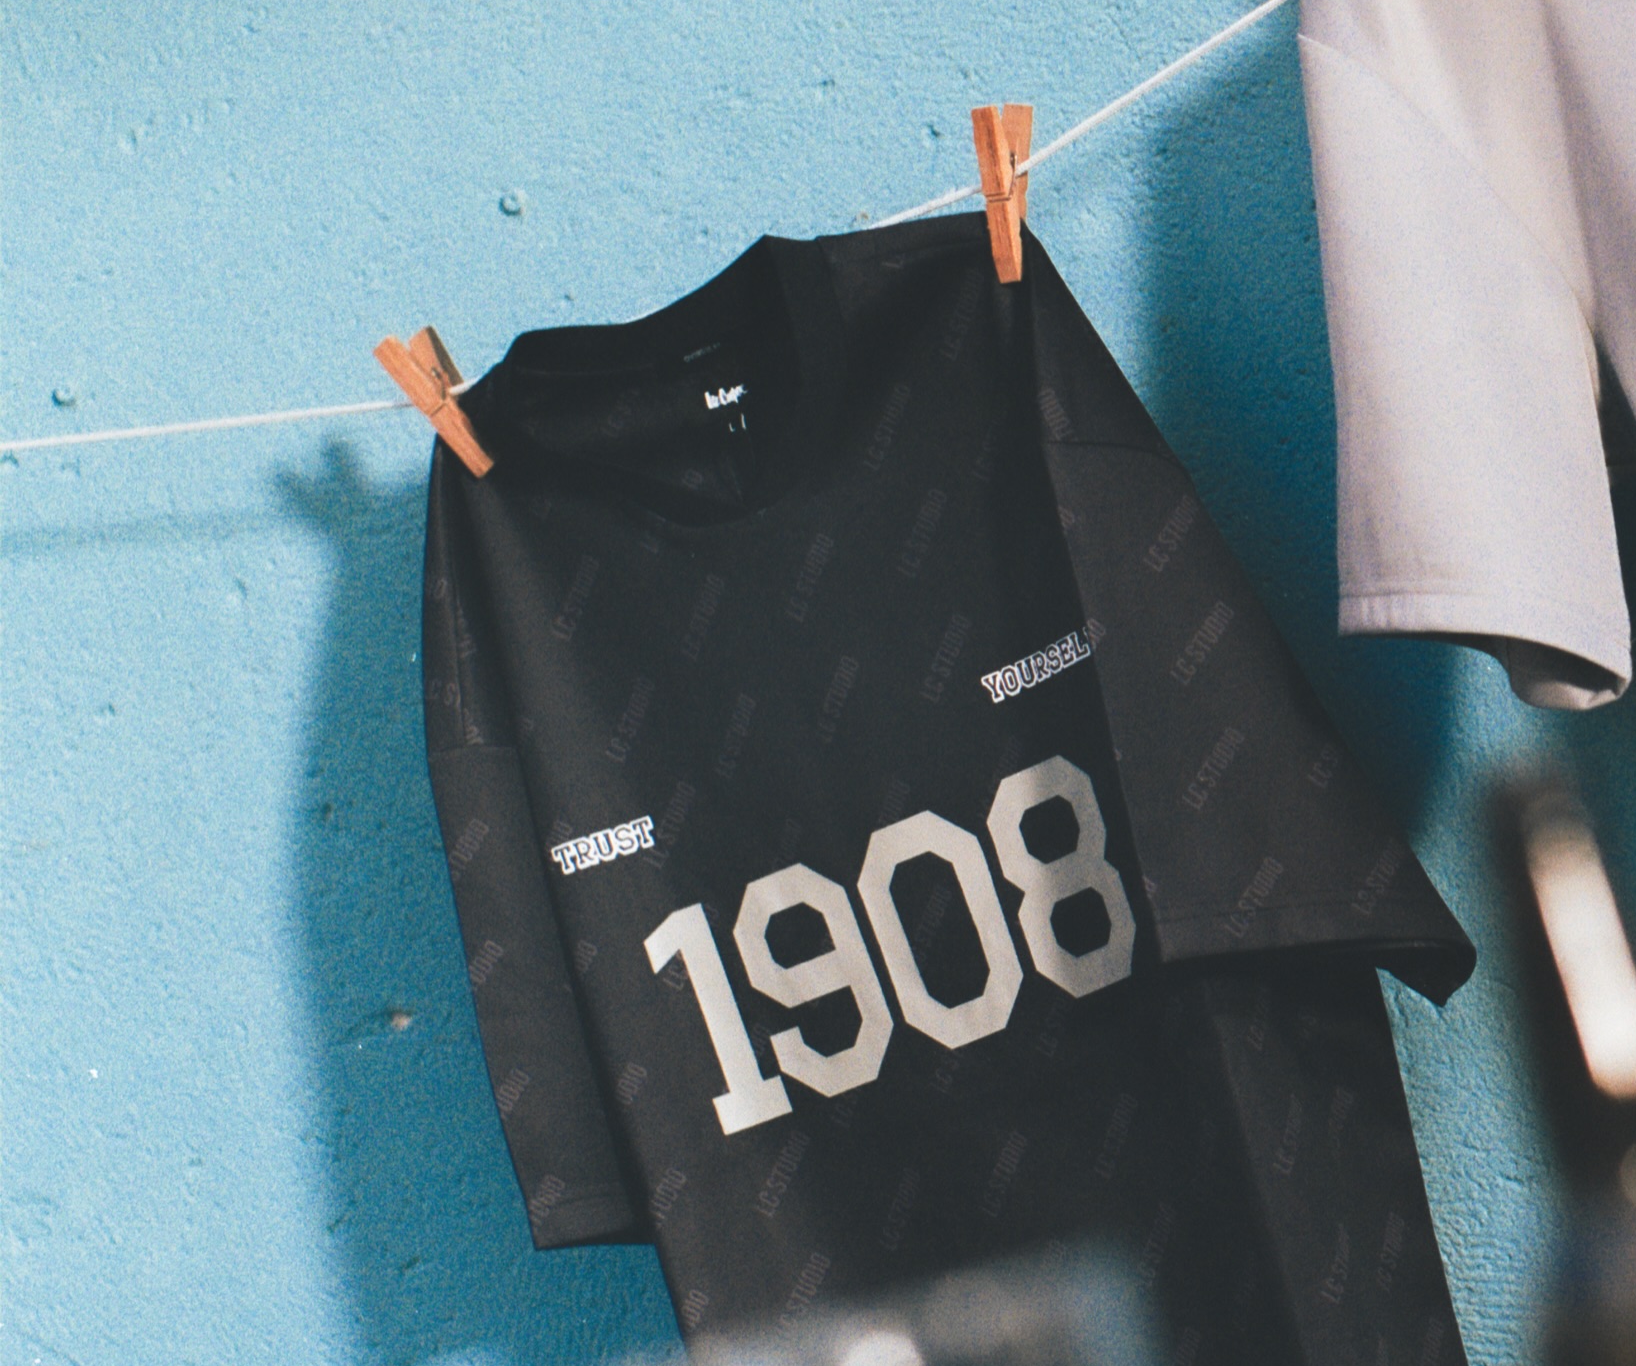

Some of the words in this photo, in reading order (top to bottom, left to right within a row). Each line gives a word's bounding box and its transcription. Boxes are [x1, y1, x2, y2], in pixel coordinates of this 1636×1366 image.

[981, 627, 1090, 704] YOURSEL
[1169, 656, 1197, 687] LC
[1184, 599, 1236, 664] STUDIO
[1182, 781, 1209, 812] LC
[1196, 726, 1246, 789] STUDIO
[551, 815, 655, 875] TRUST
[644, 755, 1137, 1135] 1908
